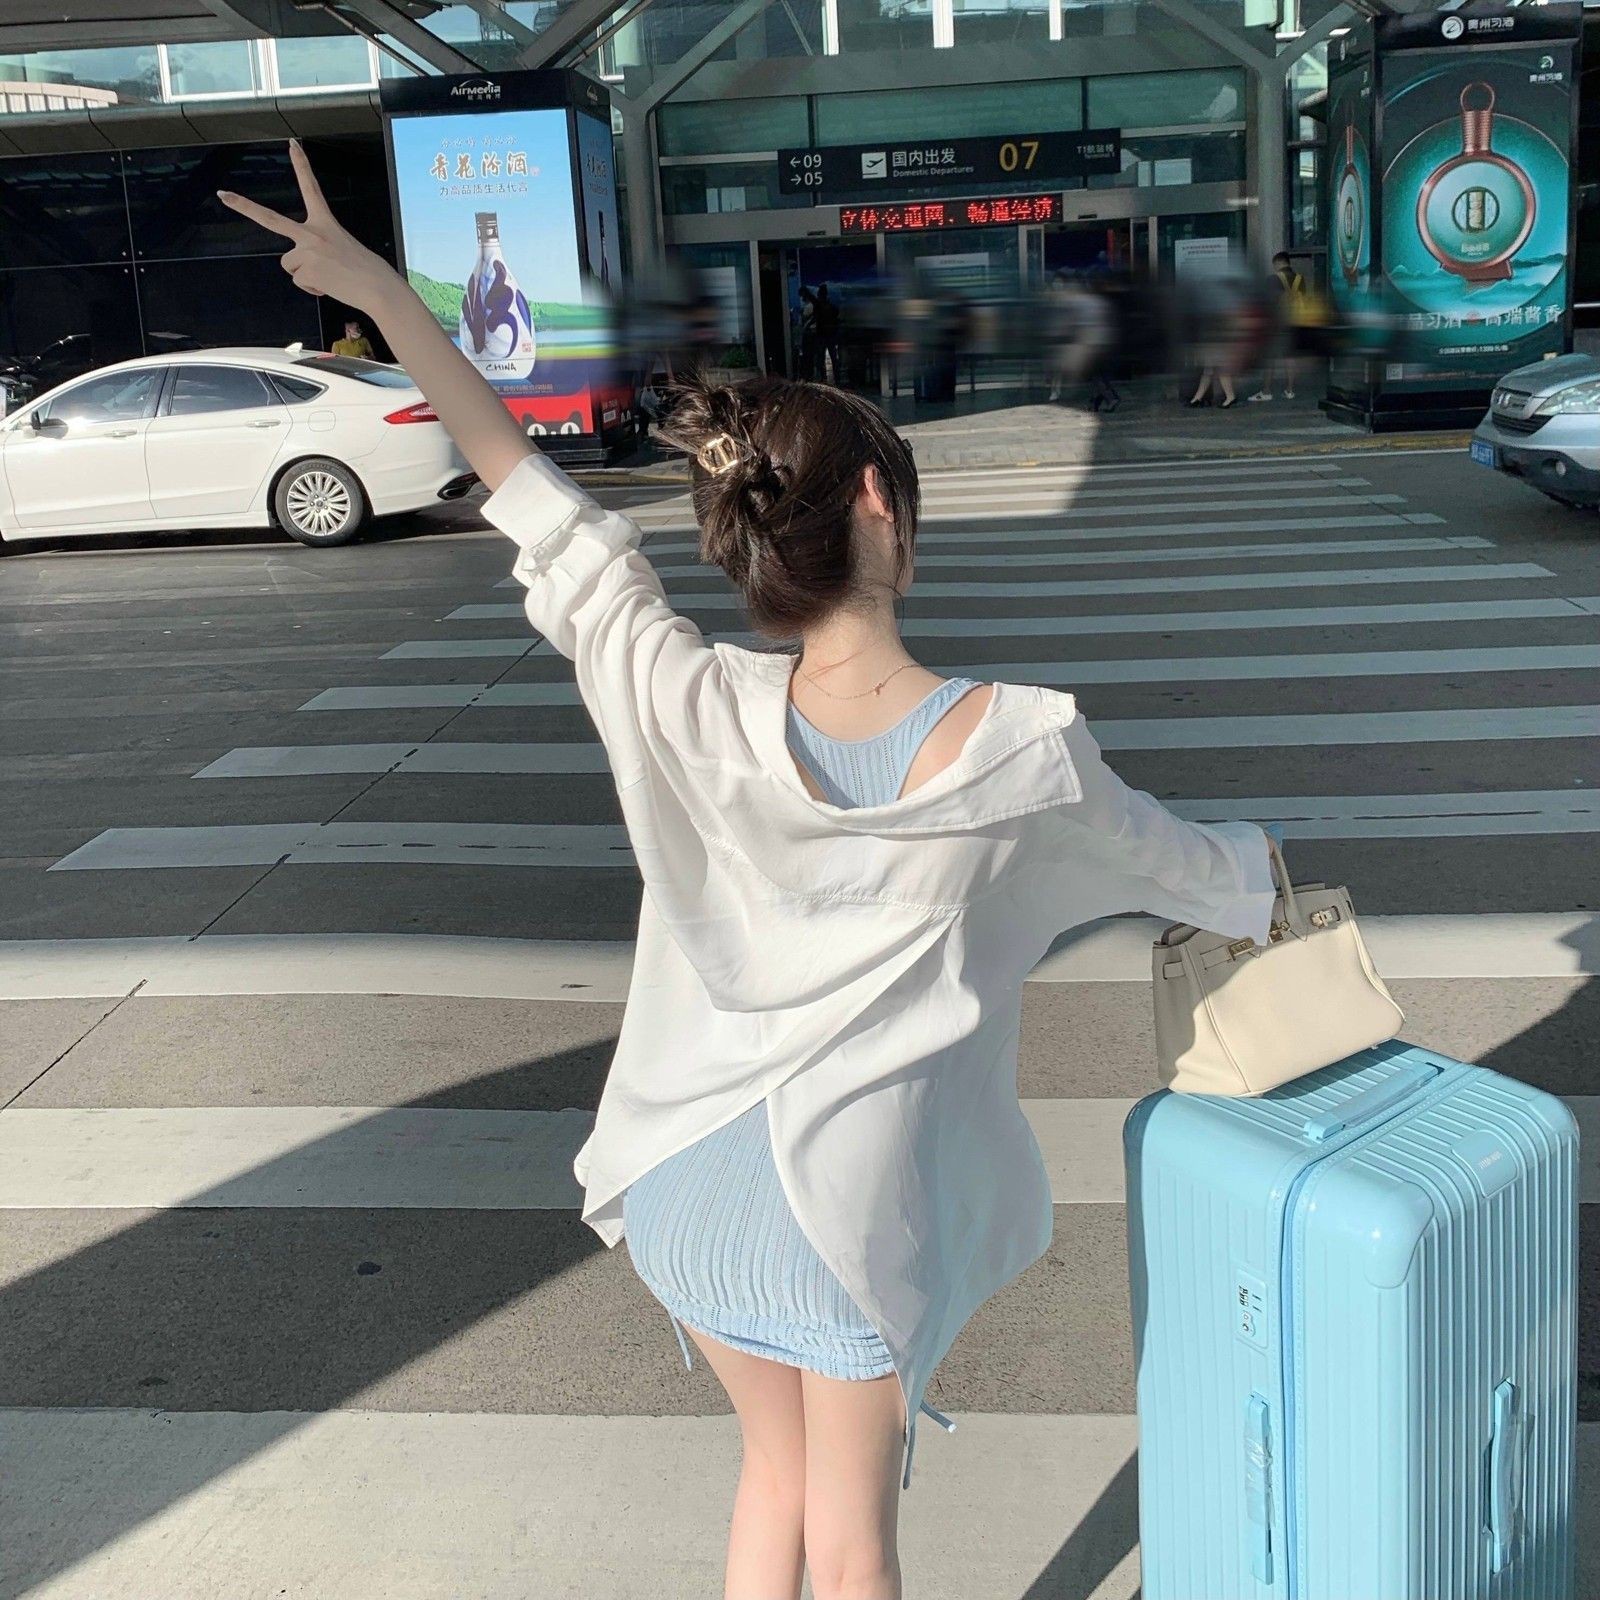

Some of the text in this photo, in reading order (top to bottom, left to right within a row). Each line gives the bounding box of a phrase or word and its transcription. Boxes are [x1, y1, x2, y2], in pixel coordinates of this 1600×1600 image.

[803, 154, 822, 168] 09
[892, 148, 956, 168] 国内出发
[999, 140, 1040, 172] 07
[430, 152, 528, 181] 青花汾酒
[893, 164, 974, 178] Domestic Departures
[804, 171, 823, 186] 05
[439, 182, 528, 196] 为高品质生活代言
[1392, 312, 1462, 330] 品习酒
[486, 362, 517, 372] CHINA
